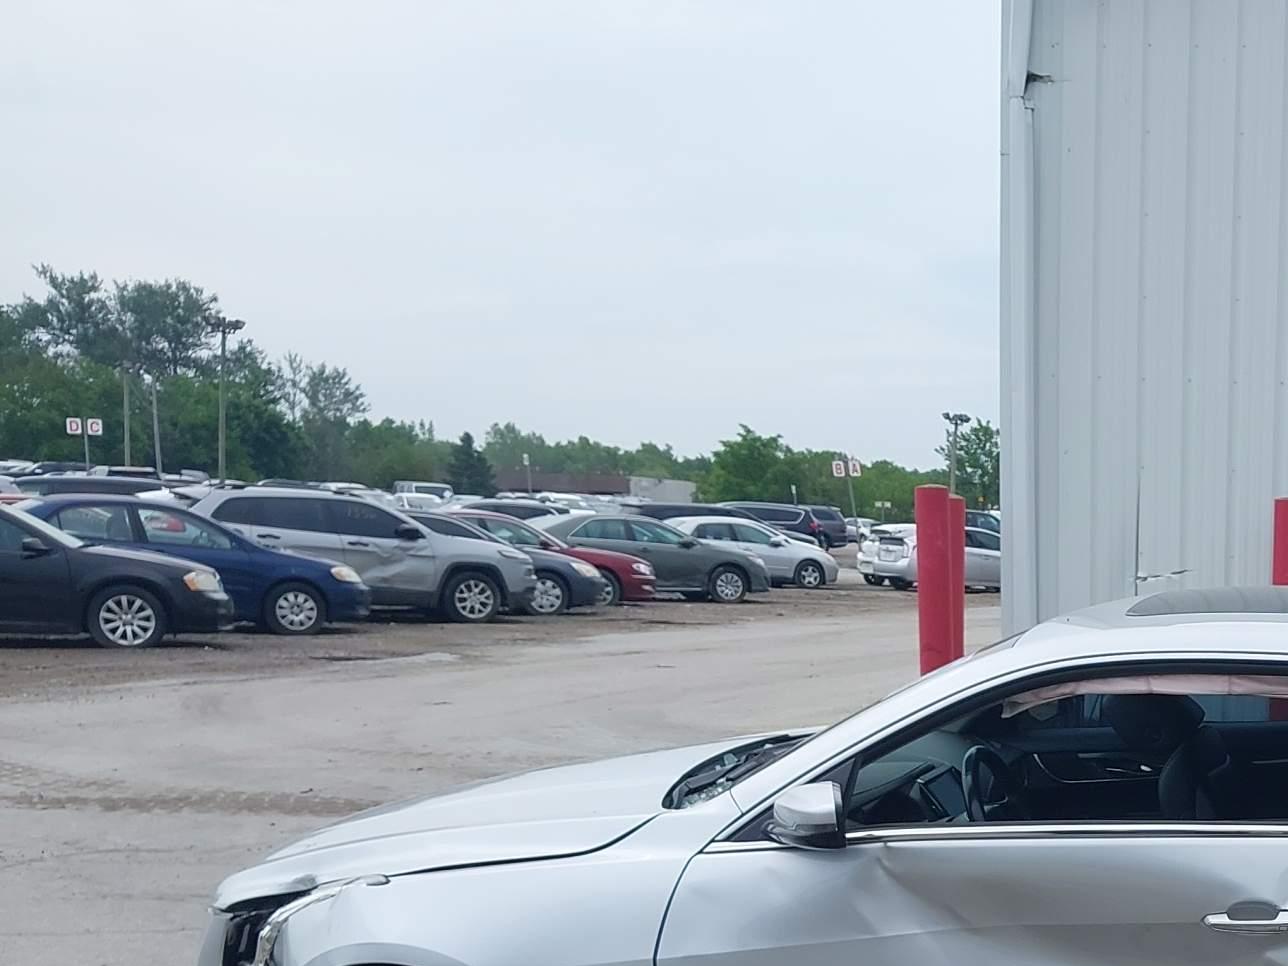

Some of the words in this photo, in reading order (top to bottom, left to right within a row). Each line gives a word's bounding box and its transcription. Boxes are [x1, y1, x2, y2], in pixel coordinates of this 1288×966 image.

[69, 420, 79, 432] D
[90, 421, 100, 433] C
[851, 463, 860, 475] A
